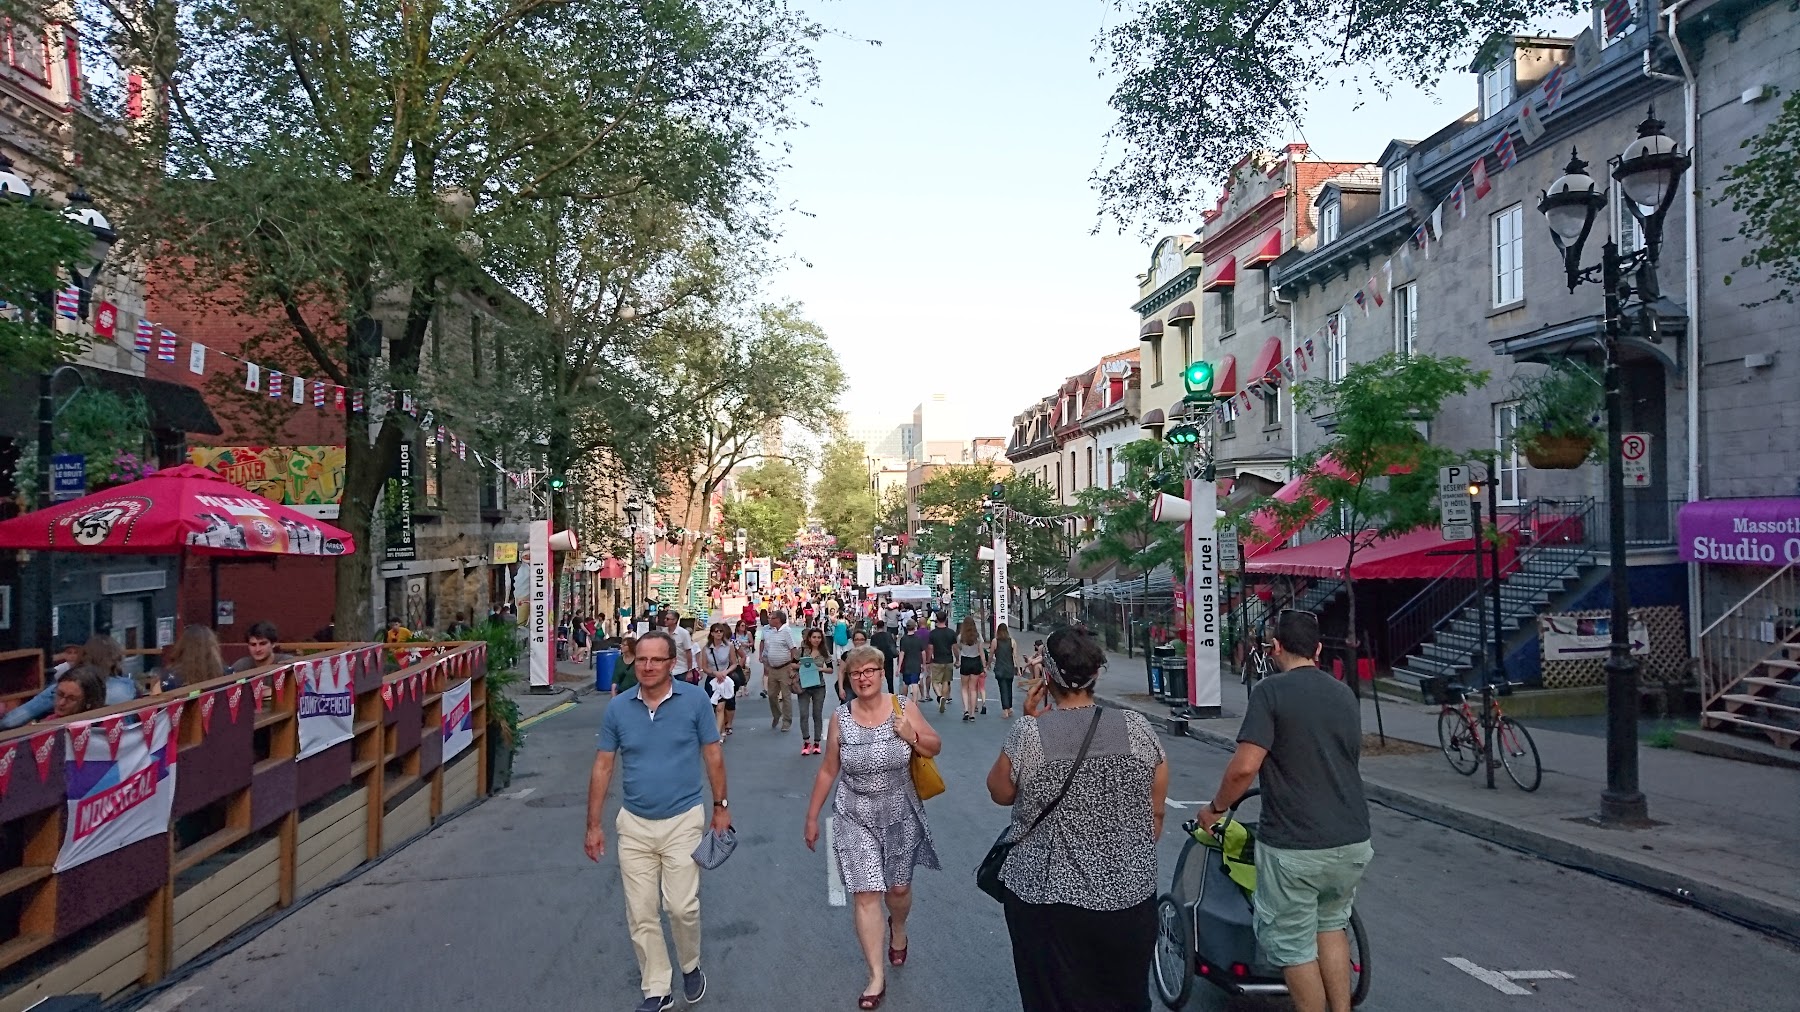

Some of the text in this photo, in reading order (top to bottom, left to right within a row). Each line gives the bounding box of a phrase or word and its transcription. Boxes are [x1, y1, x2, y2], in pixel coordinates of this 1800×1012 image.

[401, 444, 410, 477] BOÎTE
[1693, 536, 1775, 562] Studio
[998, 585, 1005, 593] la
[1200, 576, 1212, 589] la
[534, 591, 544, 601] la
[536, 604, 544, 632] nous
[1203, 594, 1214, 634] nous
[1201, 638, 1214, 647] à
